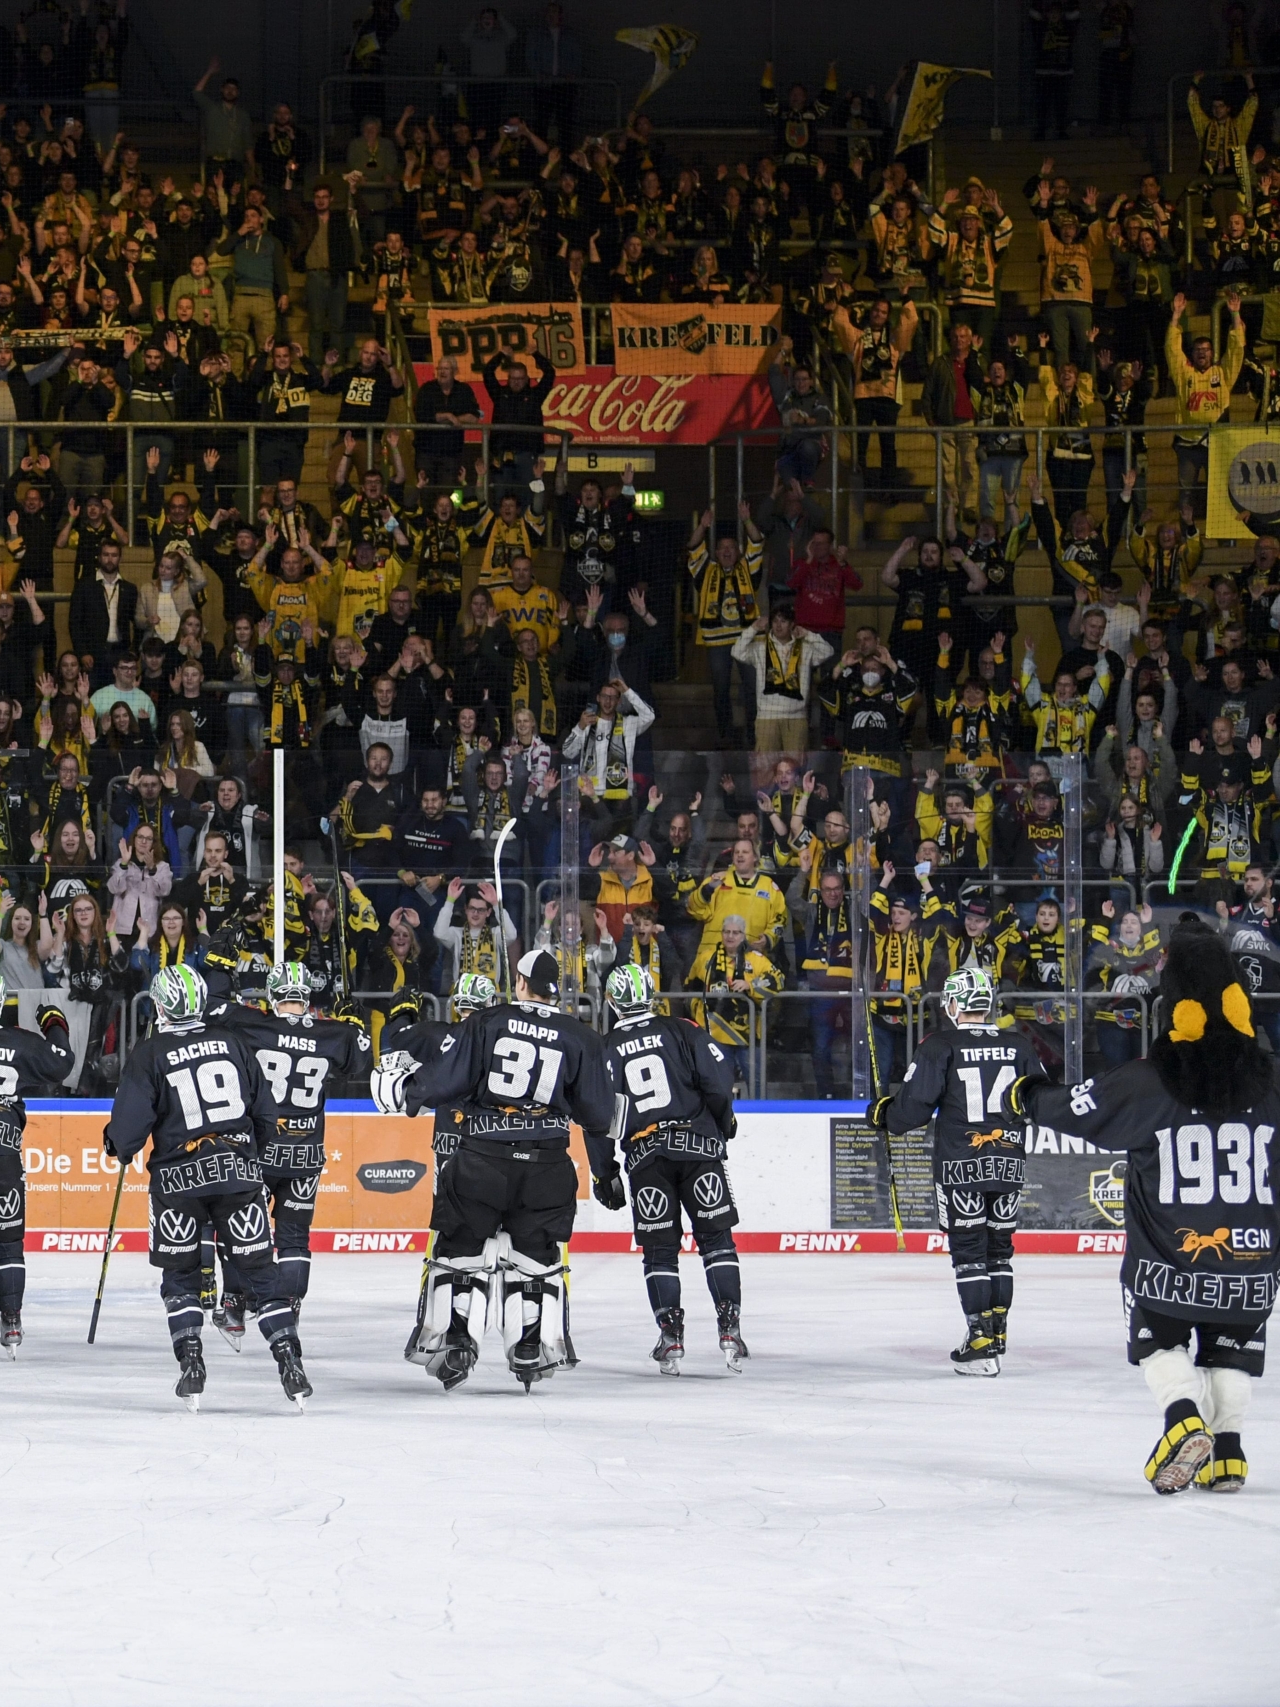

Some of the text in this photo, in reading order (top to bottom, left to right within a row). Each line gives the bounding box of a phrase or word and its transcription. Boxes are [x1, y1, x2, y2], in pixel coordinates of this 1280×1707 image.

[541, 374, 695, 433] ca-Cola
[586, 453, 598, 469] B
[414, 829, 441, 840] TOMMY
[407, 840, 444, 851] HILFIGER
[1247, 941, 1270, 951] SWK
[508, 1018, 558, 1042] QUAPP
[277, 1033, 317, 1052] MASS
[616, 1034, 664, 1058] VOLEK
[166, 1040, 229, 1066] SACHER
[961, 1047, 1017, 1061] TIFFELS
[488, 1036, 563, 1105] 31
[624, 1054, 671, 1114] 9
[166, 1060, 246, 1131] 19
[288, 1115, 317, 1130] EGN
[25, 1147, 144, 1175] Die EGN
[364, 1169, 416, 1179] CURANTO
[26, 1182, 59, 1192] Unsere
[61, 1182, 102, 1192] Nummer
[1093, 1189, 1124, 1200] KREF
[1231, 1227, 1271, 1249] EGN
